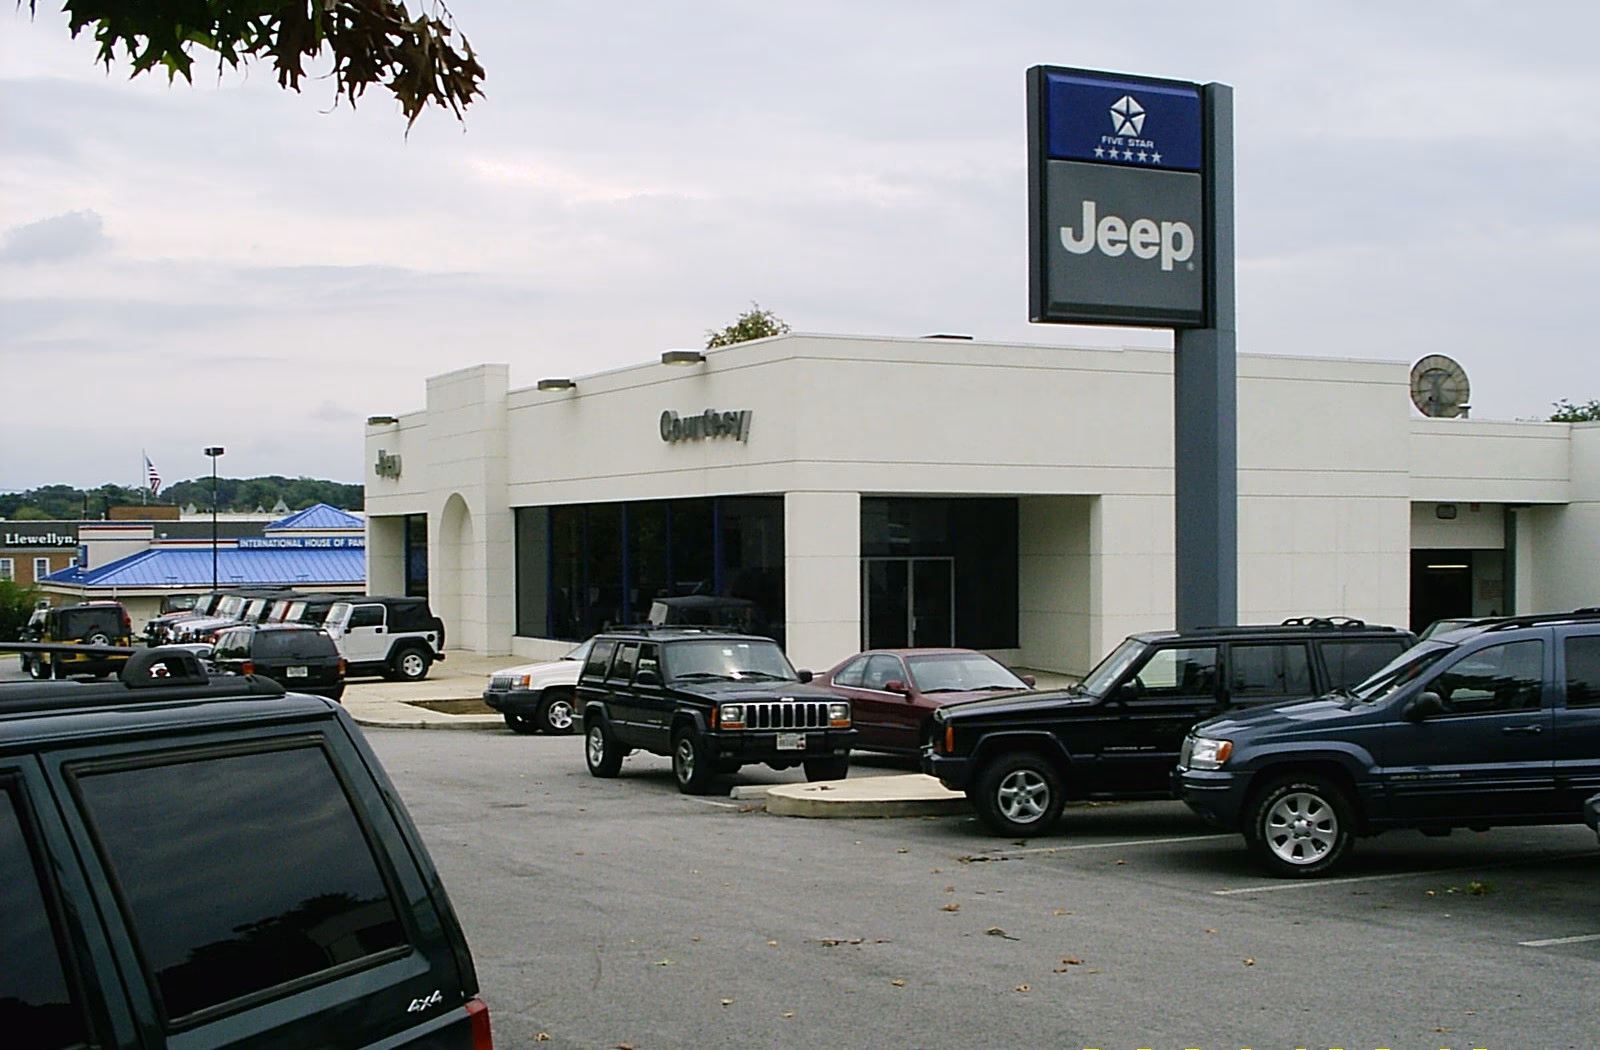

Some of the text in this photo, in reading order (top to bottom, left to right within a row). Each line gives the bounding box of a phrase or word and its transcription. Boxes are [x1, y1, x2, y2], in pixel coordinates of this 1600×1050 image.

[1102, 135, 1154, 149] FIVE STAR
[1060, 200, 1194, 271] Jeep
[5, 533, 77, 546] Llewellyn,
[239, 538, 303, 548] INTERNATIONAL
[304, 538, 331, 548] HOUSE
[333, 538, 345, 548] OF
